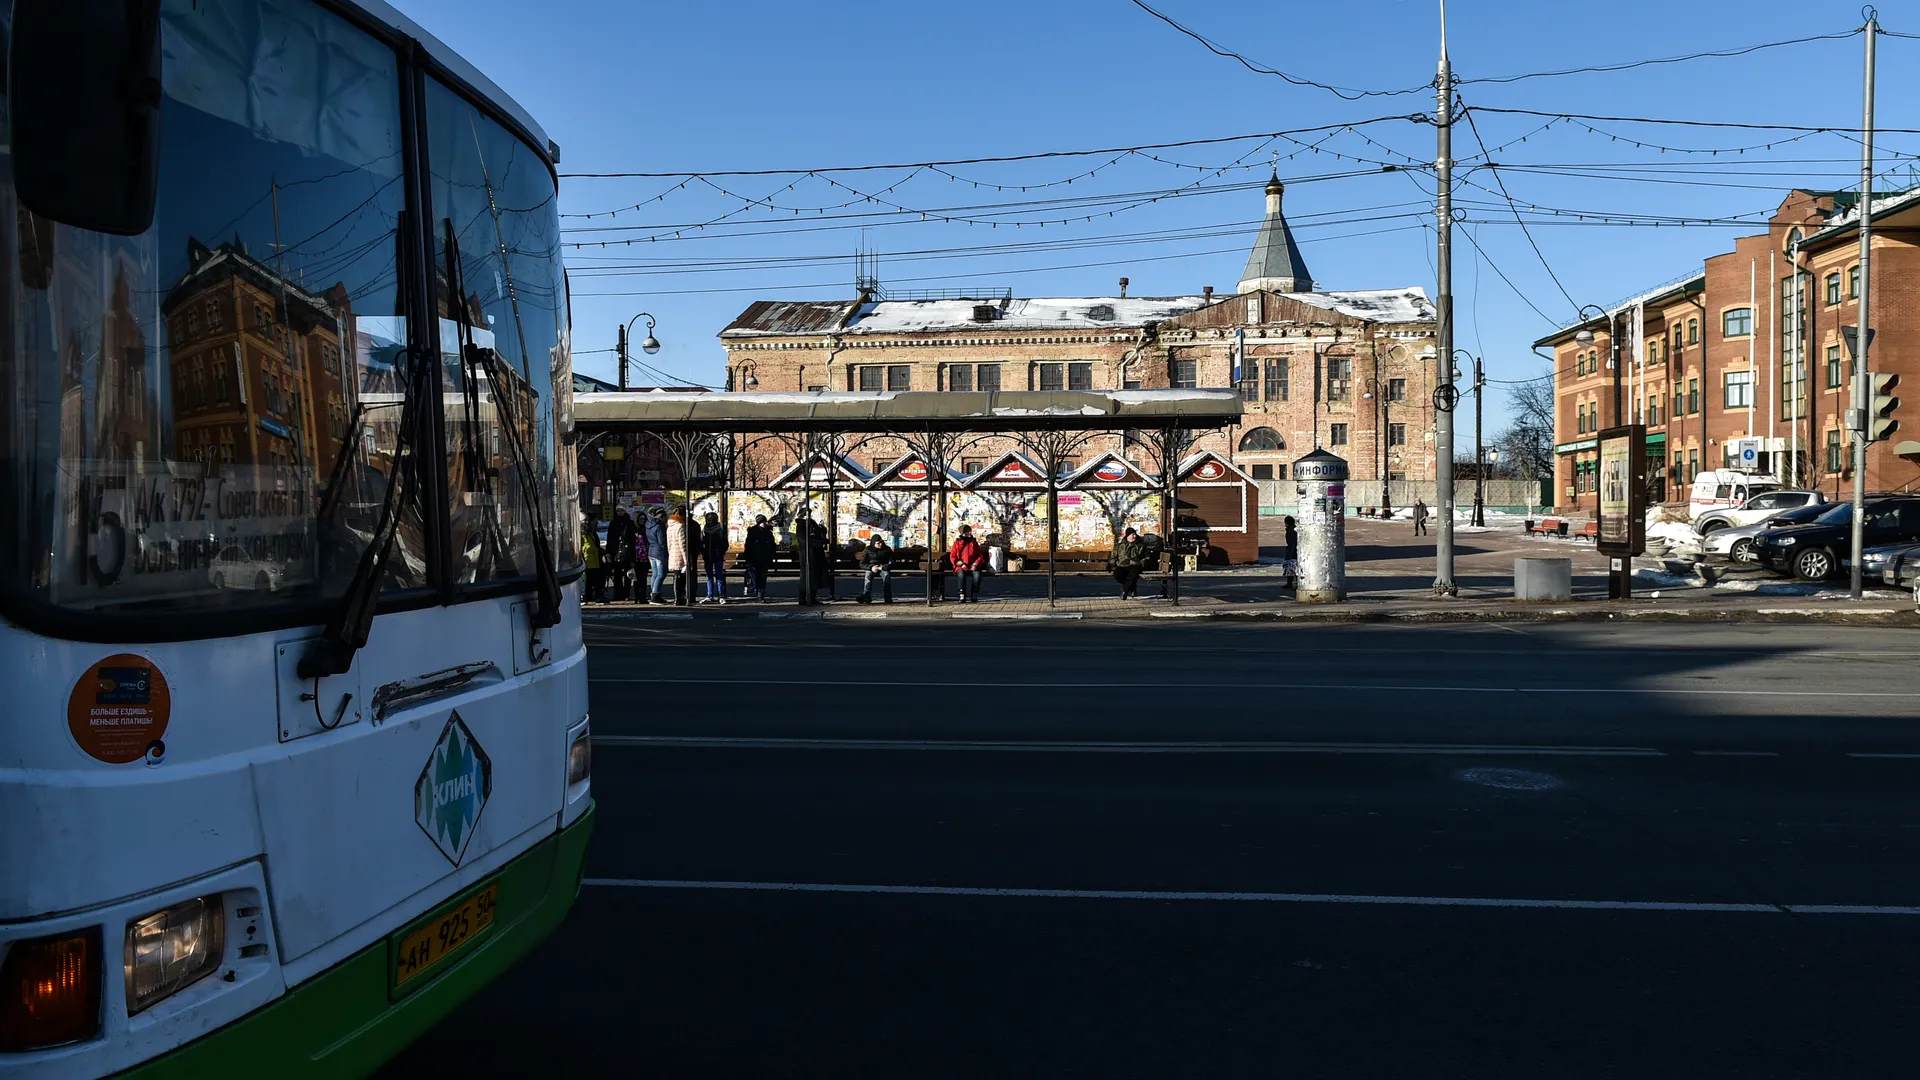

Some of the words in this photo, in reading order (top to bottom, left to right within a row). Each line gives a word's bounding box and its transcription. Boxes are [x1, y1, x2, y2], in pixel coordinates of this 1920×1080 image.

[89, 718, 119, 726] МЕНЬШЕ
[120, 717, 153, 725] ПЛАТИШЬ!
[90, 708, 119, 716] БОЛЬШЕ
[120, 707, 147, 716] ЕЗДИШЬ
[433, 772, 475, 808] КЛИН
[439, 905, 471, 953] 925
[476, 890, 491, 919] 50
